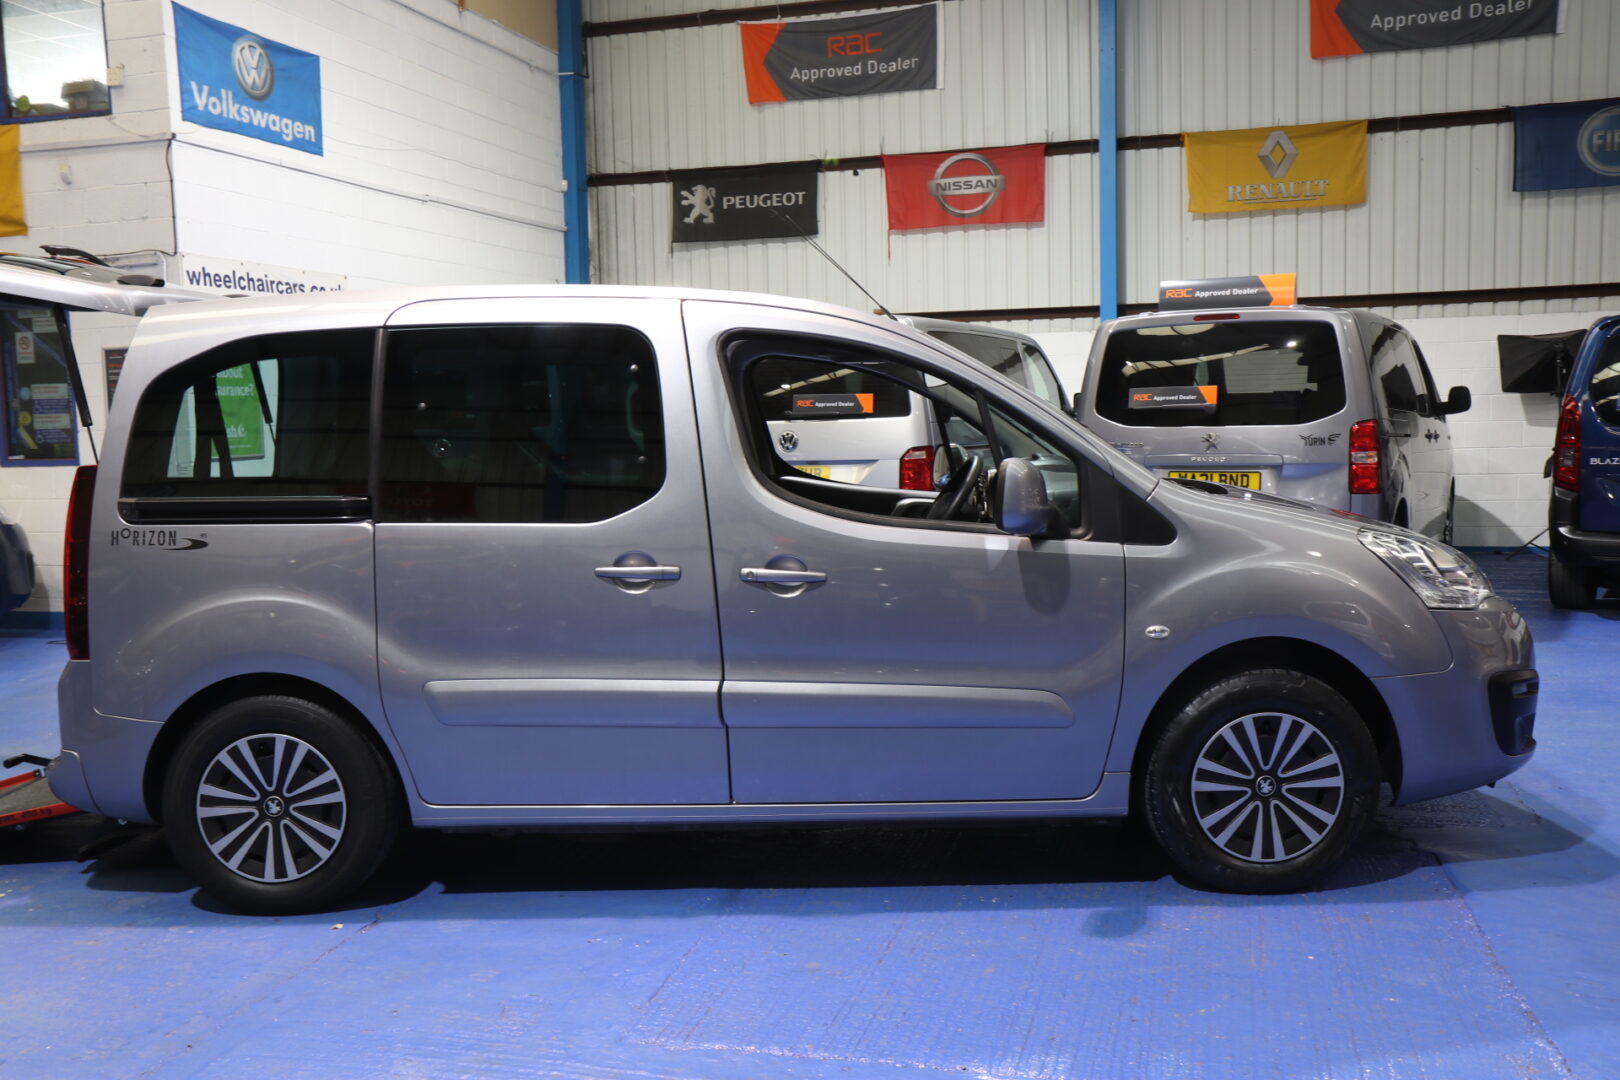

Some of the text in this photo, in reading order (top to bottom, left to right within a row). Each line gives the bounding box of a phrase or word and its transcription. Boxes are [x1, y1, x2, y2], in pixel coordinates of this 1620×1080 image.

[1370, 0, 1532, 31] Approved Dealer
[790, 57, 919, 83] Approved Dealer
[190, 80, 316, 142] Volkswagen
[935, 178, 998, 192] NISSAN
[1226, 179, 1329, 202] RENAULT
[722, 191, 807, 210] PEUGEOT
[186, 266, 344, 295] wheelchaircars
[1195, 288, 1231, 298] Approved
[1232, 287, 1259, 295] Dealer
